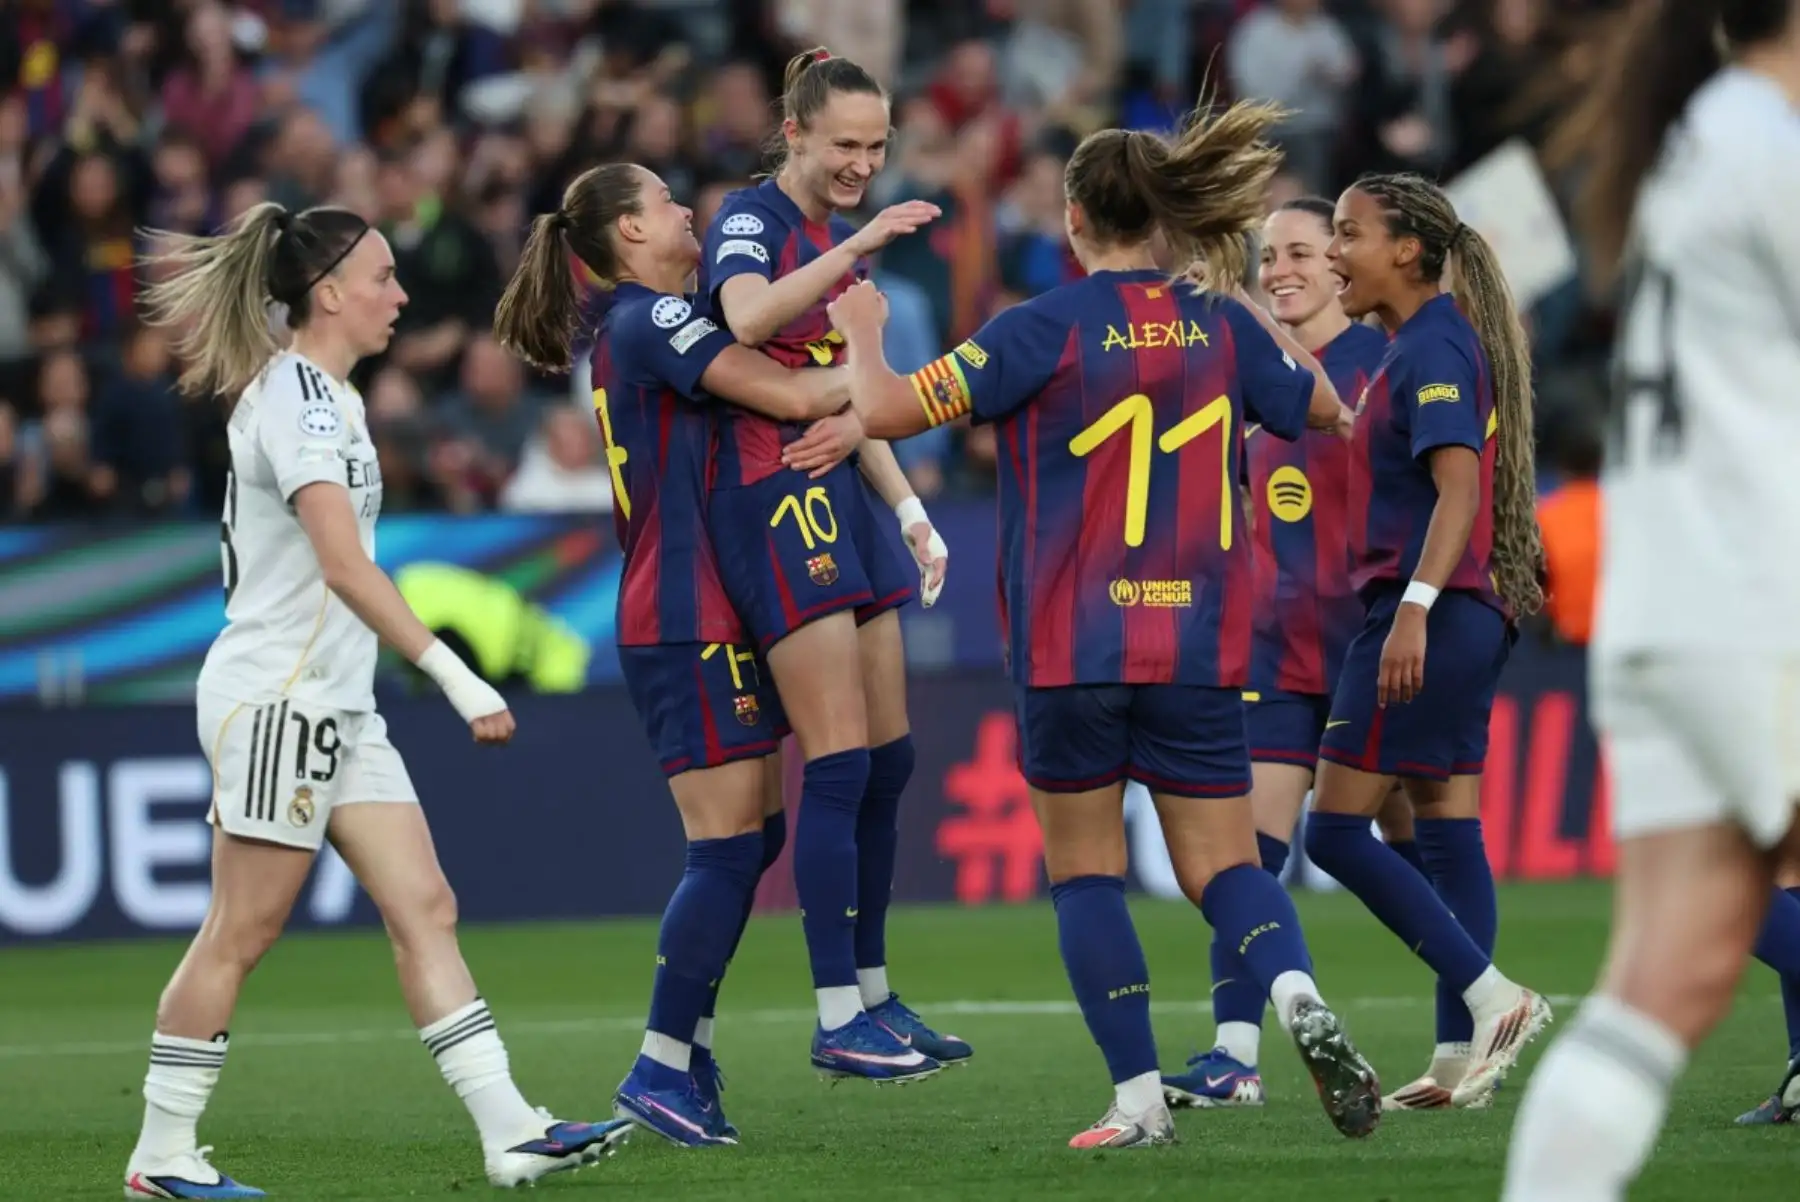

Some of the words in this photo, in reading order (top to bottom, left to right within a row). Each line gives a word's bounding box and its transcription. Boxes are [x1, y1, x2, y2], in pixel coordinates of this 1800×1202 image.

[1101, 319, 1209, 352] ALEXIA
[1418, 385, 1459, 402] BIMBO
[1069, 393, 1233, 551] 11
[770, 486, 838, 550] 10
[1142, 580, 1192, 592] UNHCR
[1142, 592, 1192, 603] ACNUR
[291, 710, 341, 782] 19
